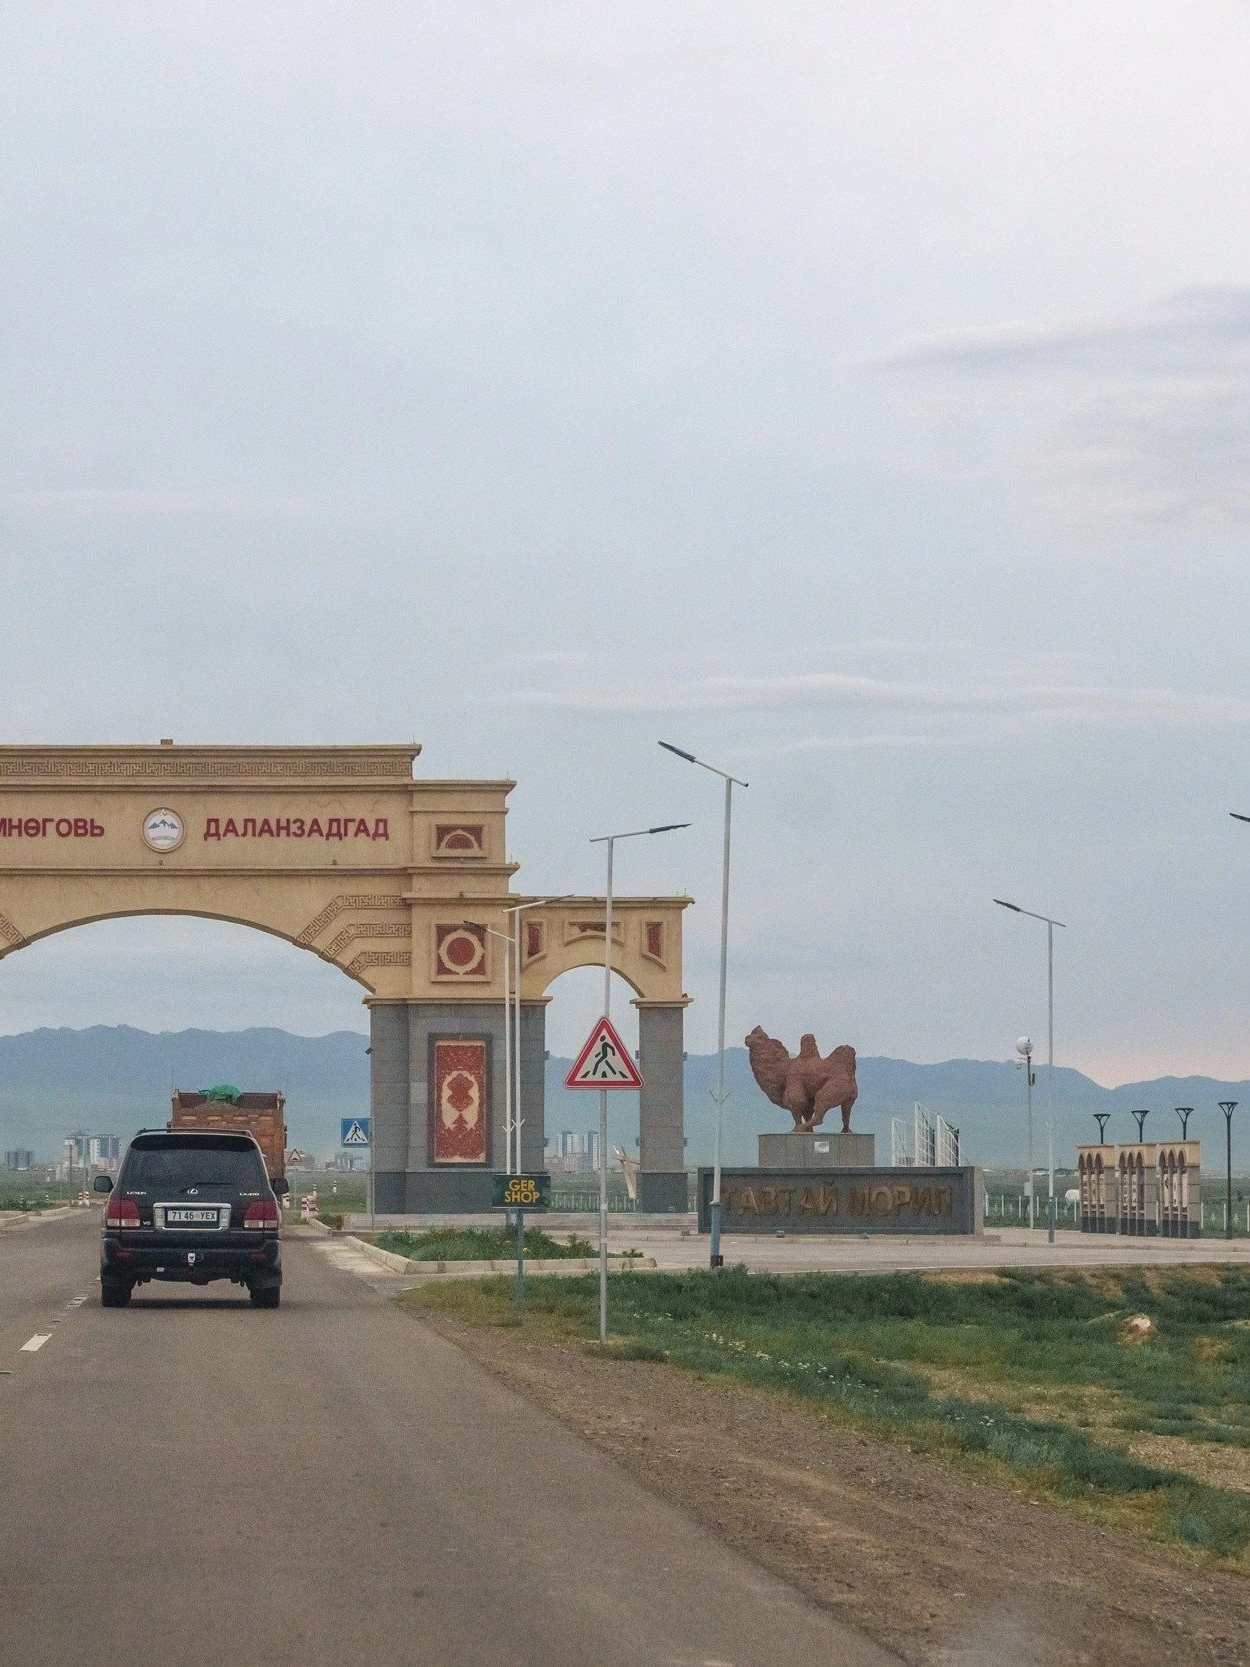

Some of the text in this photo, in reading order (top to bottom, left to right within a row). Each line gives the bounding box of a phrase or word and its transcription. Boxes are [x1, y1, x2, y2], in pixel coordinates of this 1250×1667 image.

[203, 817, 390, 841] ДАЛАНЗАДГАД
[509, 1179, 536, 1192] GER
[504, 1191, 540, 1203] SHOP
